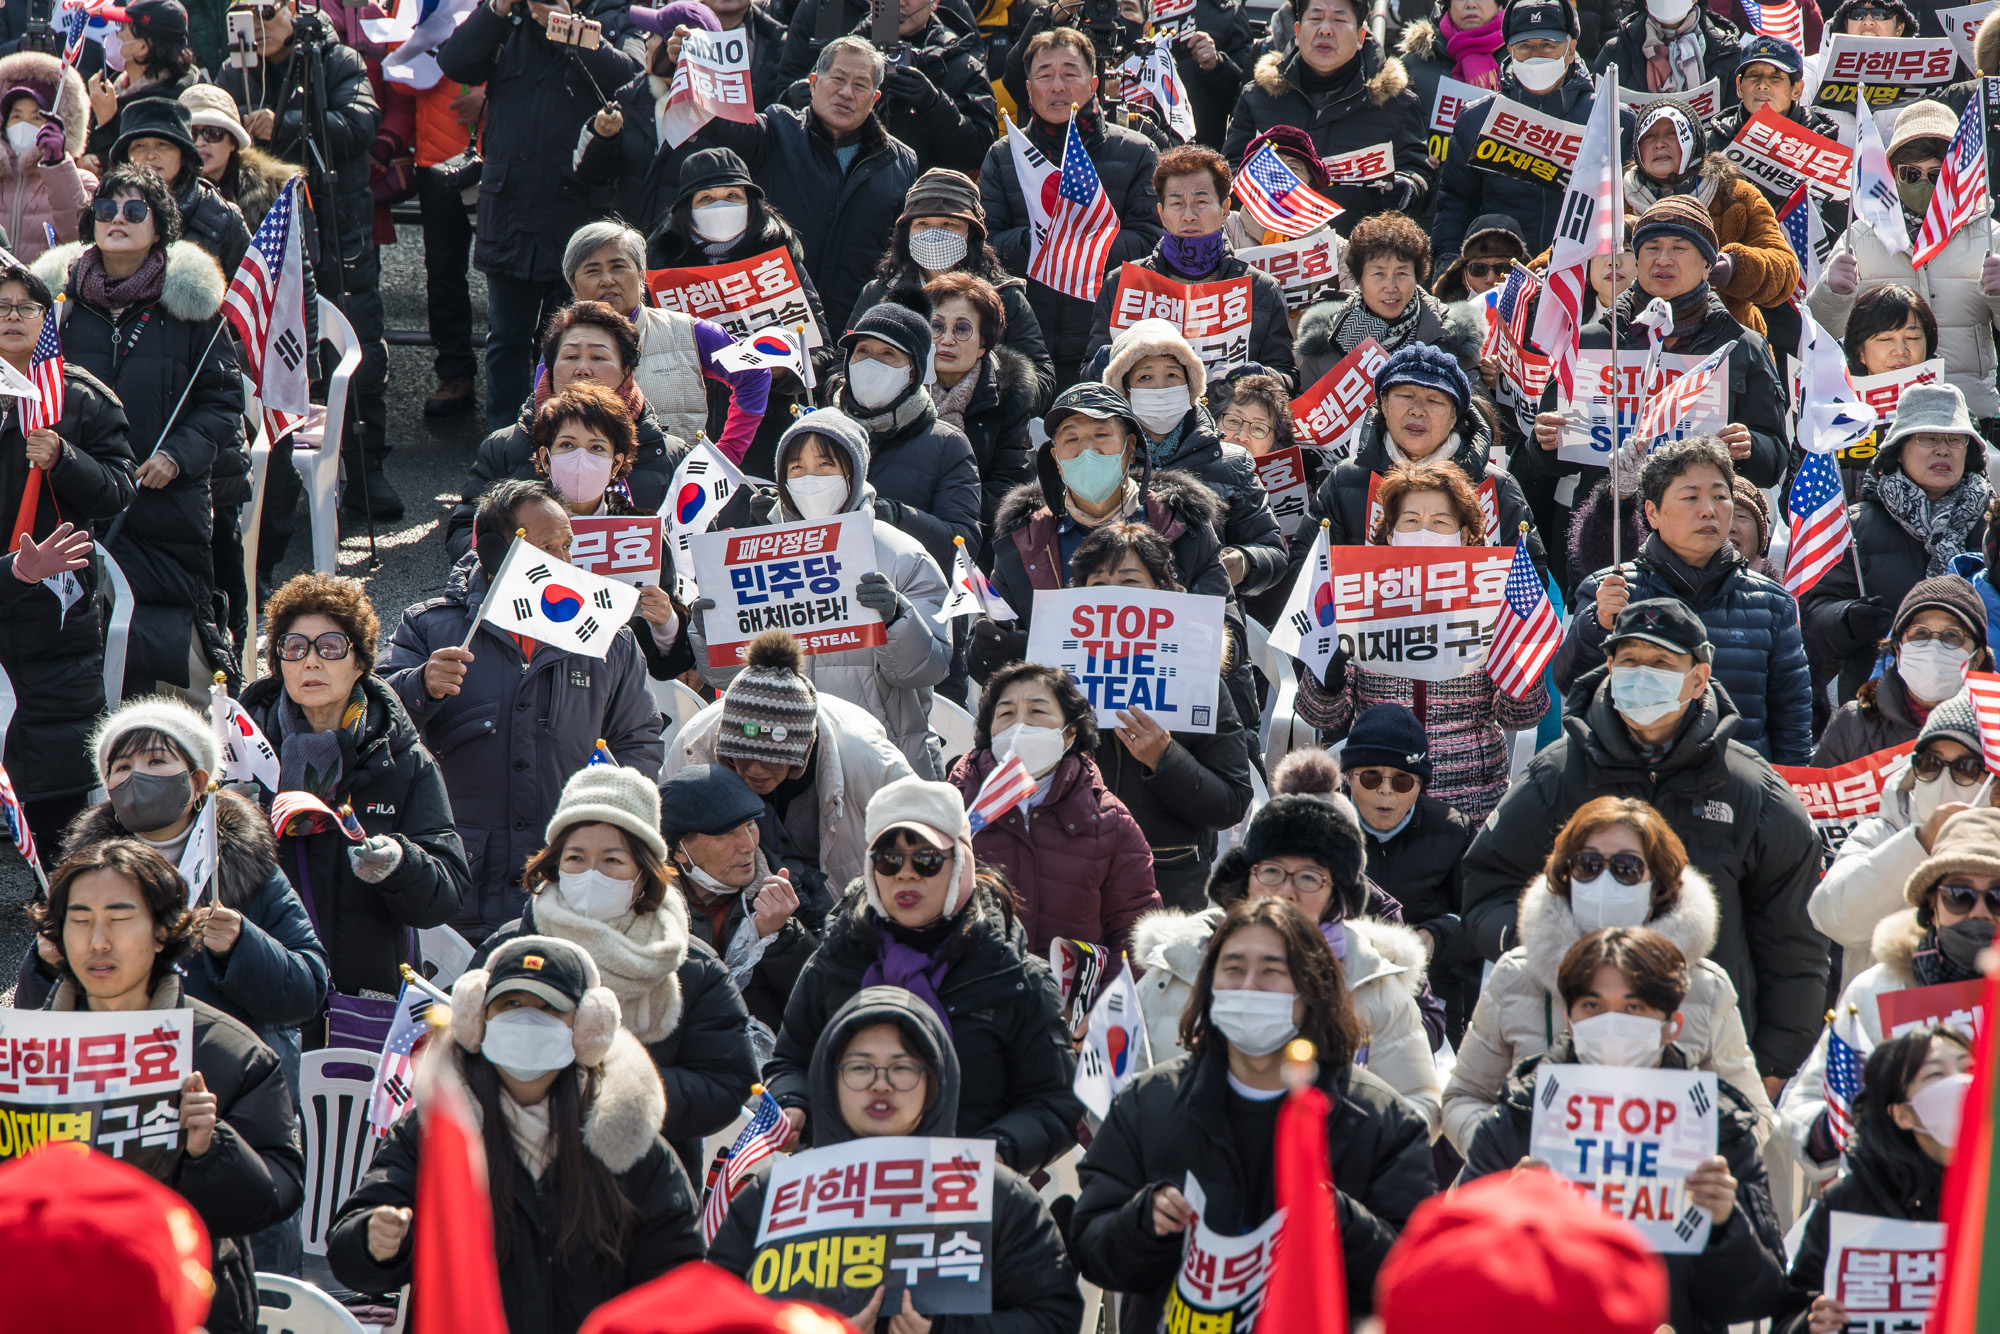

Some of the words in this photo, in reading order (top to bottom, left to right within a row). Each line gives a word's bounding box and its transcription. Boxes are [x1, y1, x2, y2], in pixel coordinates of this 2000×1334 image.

[1832, 48, 1952, 81] 탄핵무효
[1490, 111, 1584, 165] 탄핵무
[1741, 121, 1853, 187] 탄핵무
[1328, 150, 1386, 179] 무효
[1476, 139, 1559, 181] 이재명
[1251, 242, 1331, 285] 무효
[656, 257, 793, 313] 탄핵무효
[1117, 286, 1247, 336] 탄핵무효
[572, 525, 653, 571] 무효
[737, 528, 828, 561] 패악정당
[730, 555, 842, 606] 민주당
[1334, 556, 1512, 622] 탄핵무효
[736, 596, 848, 634] 해체하라!
[1070, 605, 1175, 639] STOP
[810, 632, 860, 648] STEAL
[1082, 641, 1157, 675] THE
[1339, 624, 1438, 662] 이재명
[1074, 675, 1177, 712] TEAL
[1707, 800, 1721, 808] THE
[1790, 752, 1916, 816] 핵무
[367, 803, 396, 814] FILA
[97, 1100, 181, 1158] 구속
[1565, 1094, 1677, 1135] STOP
[1575, 1138, 1660, 1177] THE
[767, 1155, 981, 1234] 탄핵무효
[1573, 1181, 1674, 1221] TEAL
[752, 1235, 886, 1294] 이재명
[890, 1231, 984, 1286] 구속
[1184, 1215, 1284, 1301] 핵무
[1842, 1251, 1946, 1309] 불법
